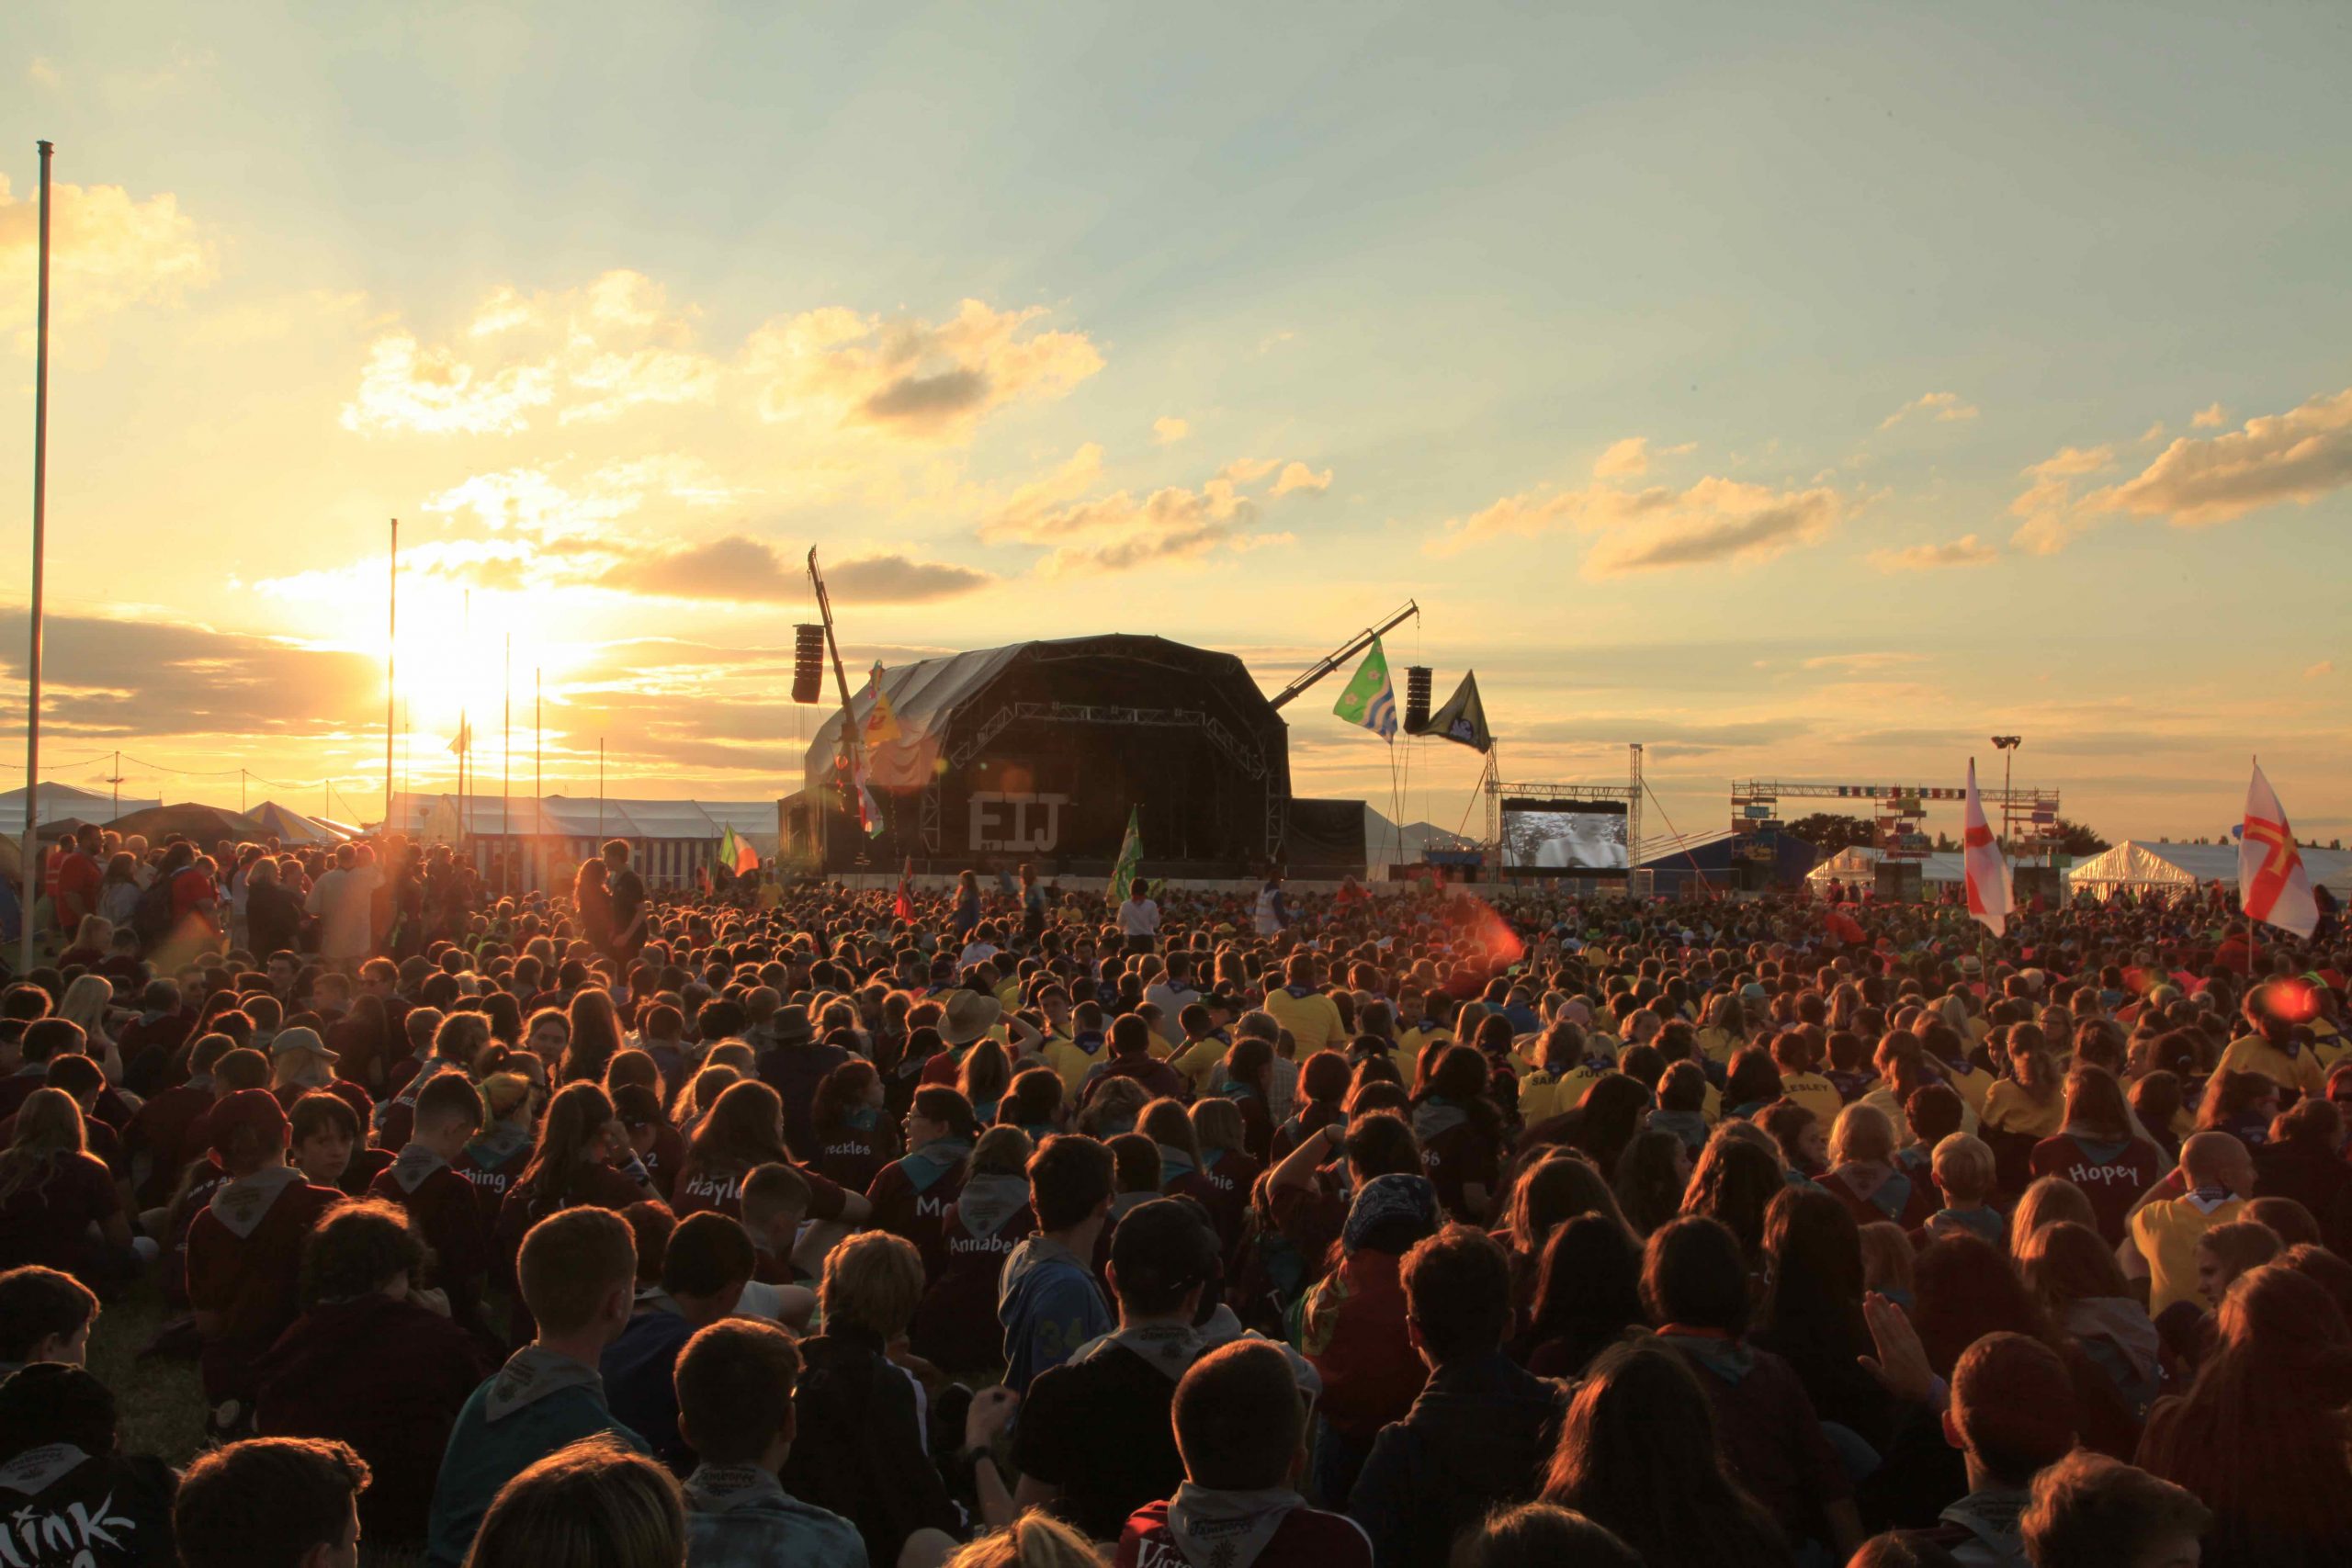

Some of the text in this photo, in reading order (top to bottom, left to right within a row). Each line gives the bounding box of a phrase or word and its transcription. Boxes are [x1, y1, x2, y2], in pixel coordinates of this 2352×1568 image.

[824, 1140, 872, 1155] reckles
[460, 1168, 506, 1194] hing
[1208, 1171, 1235, 1190] hie
[2068, 1163, 2140, 1187] Hopey
